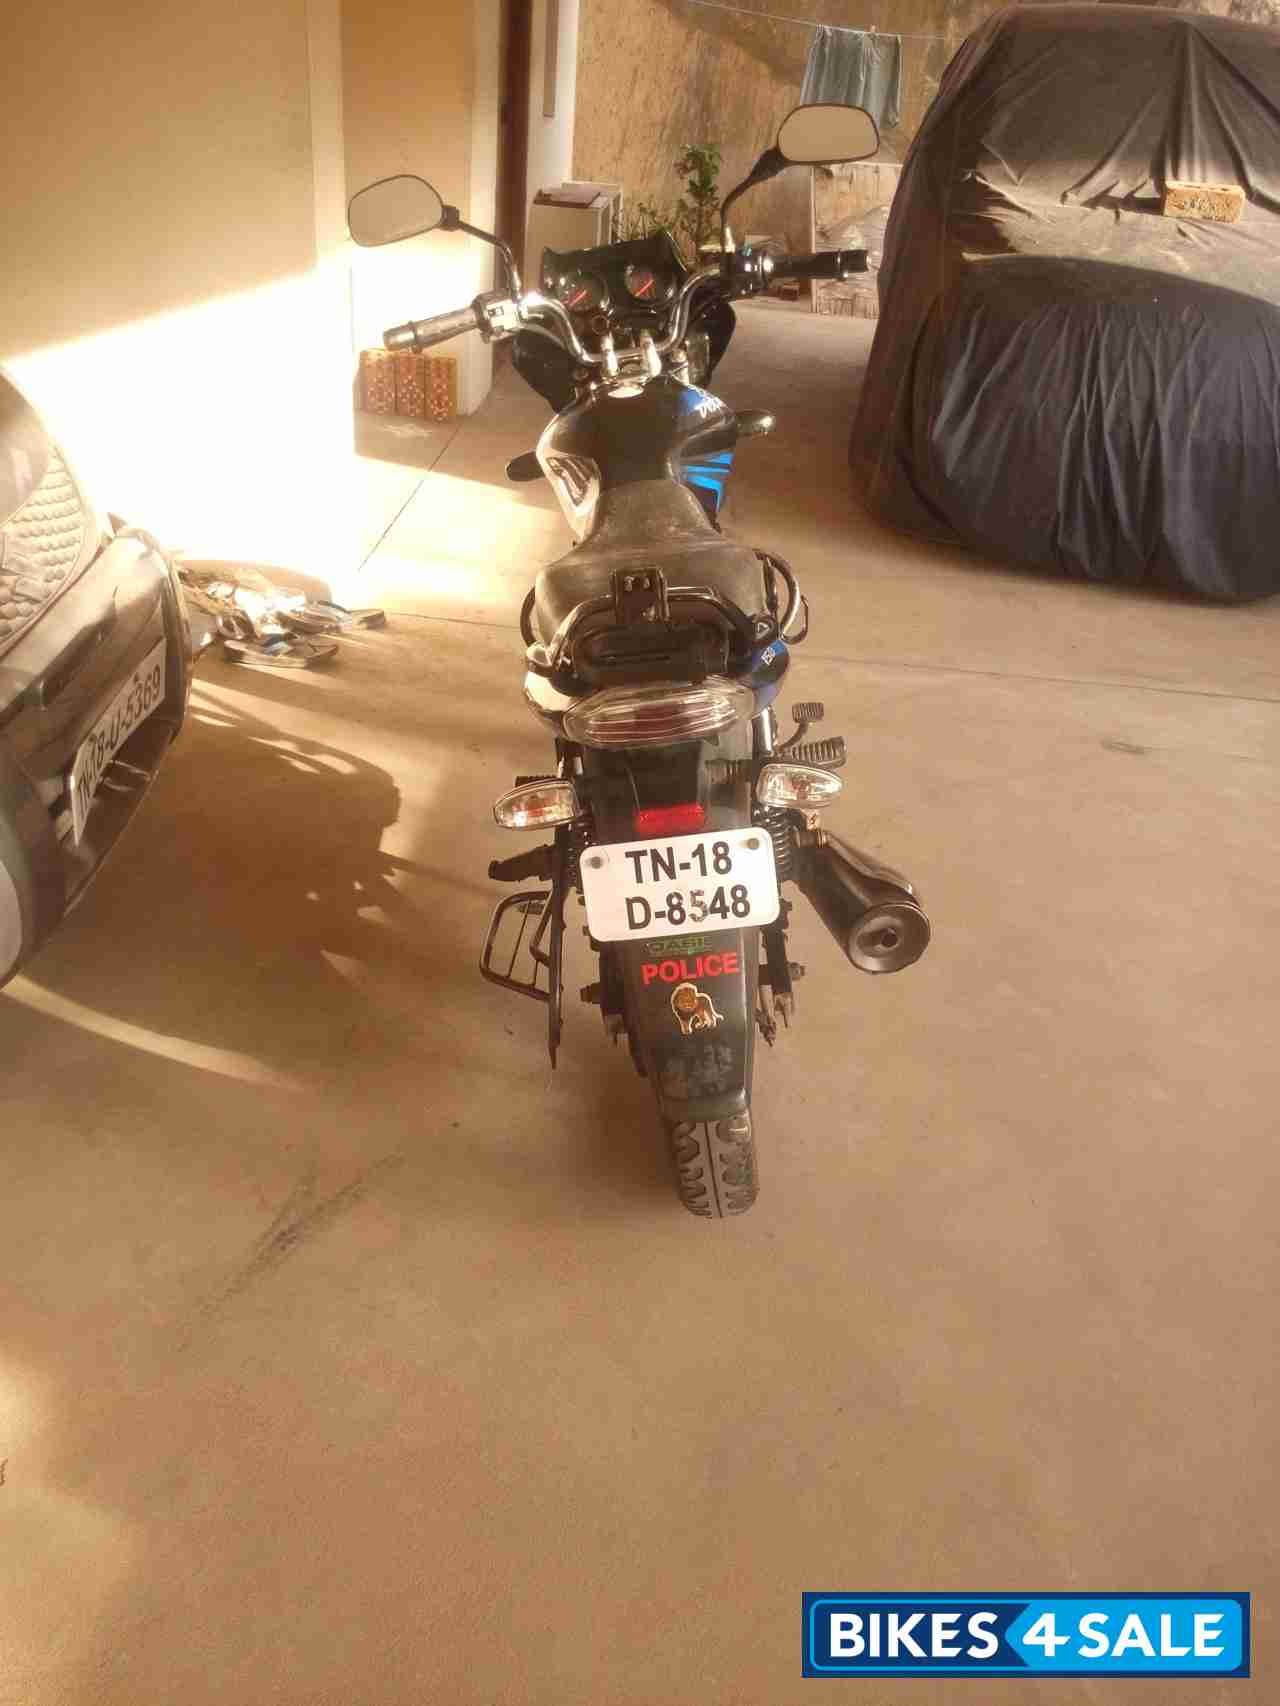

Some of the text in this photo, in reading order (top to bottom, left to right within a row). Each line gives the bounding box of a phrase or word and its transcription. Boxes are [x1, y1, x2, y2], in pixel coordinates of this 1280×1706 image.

[625, 841, 732, 884] TN-18
[625, 884, 750, 930] D-8548
[640, 952, 739, 985] POLICE
